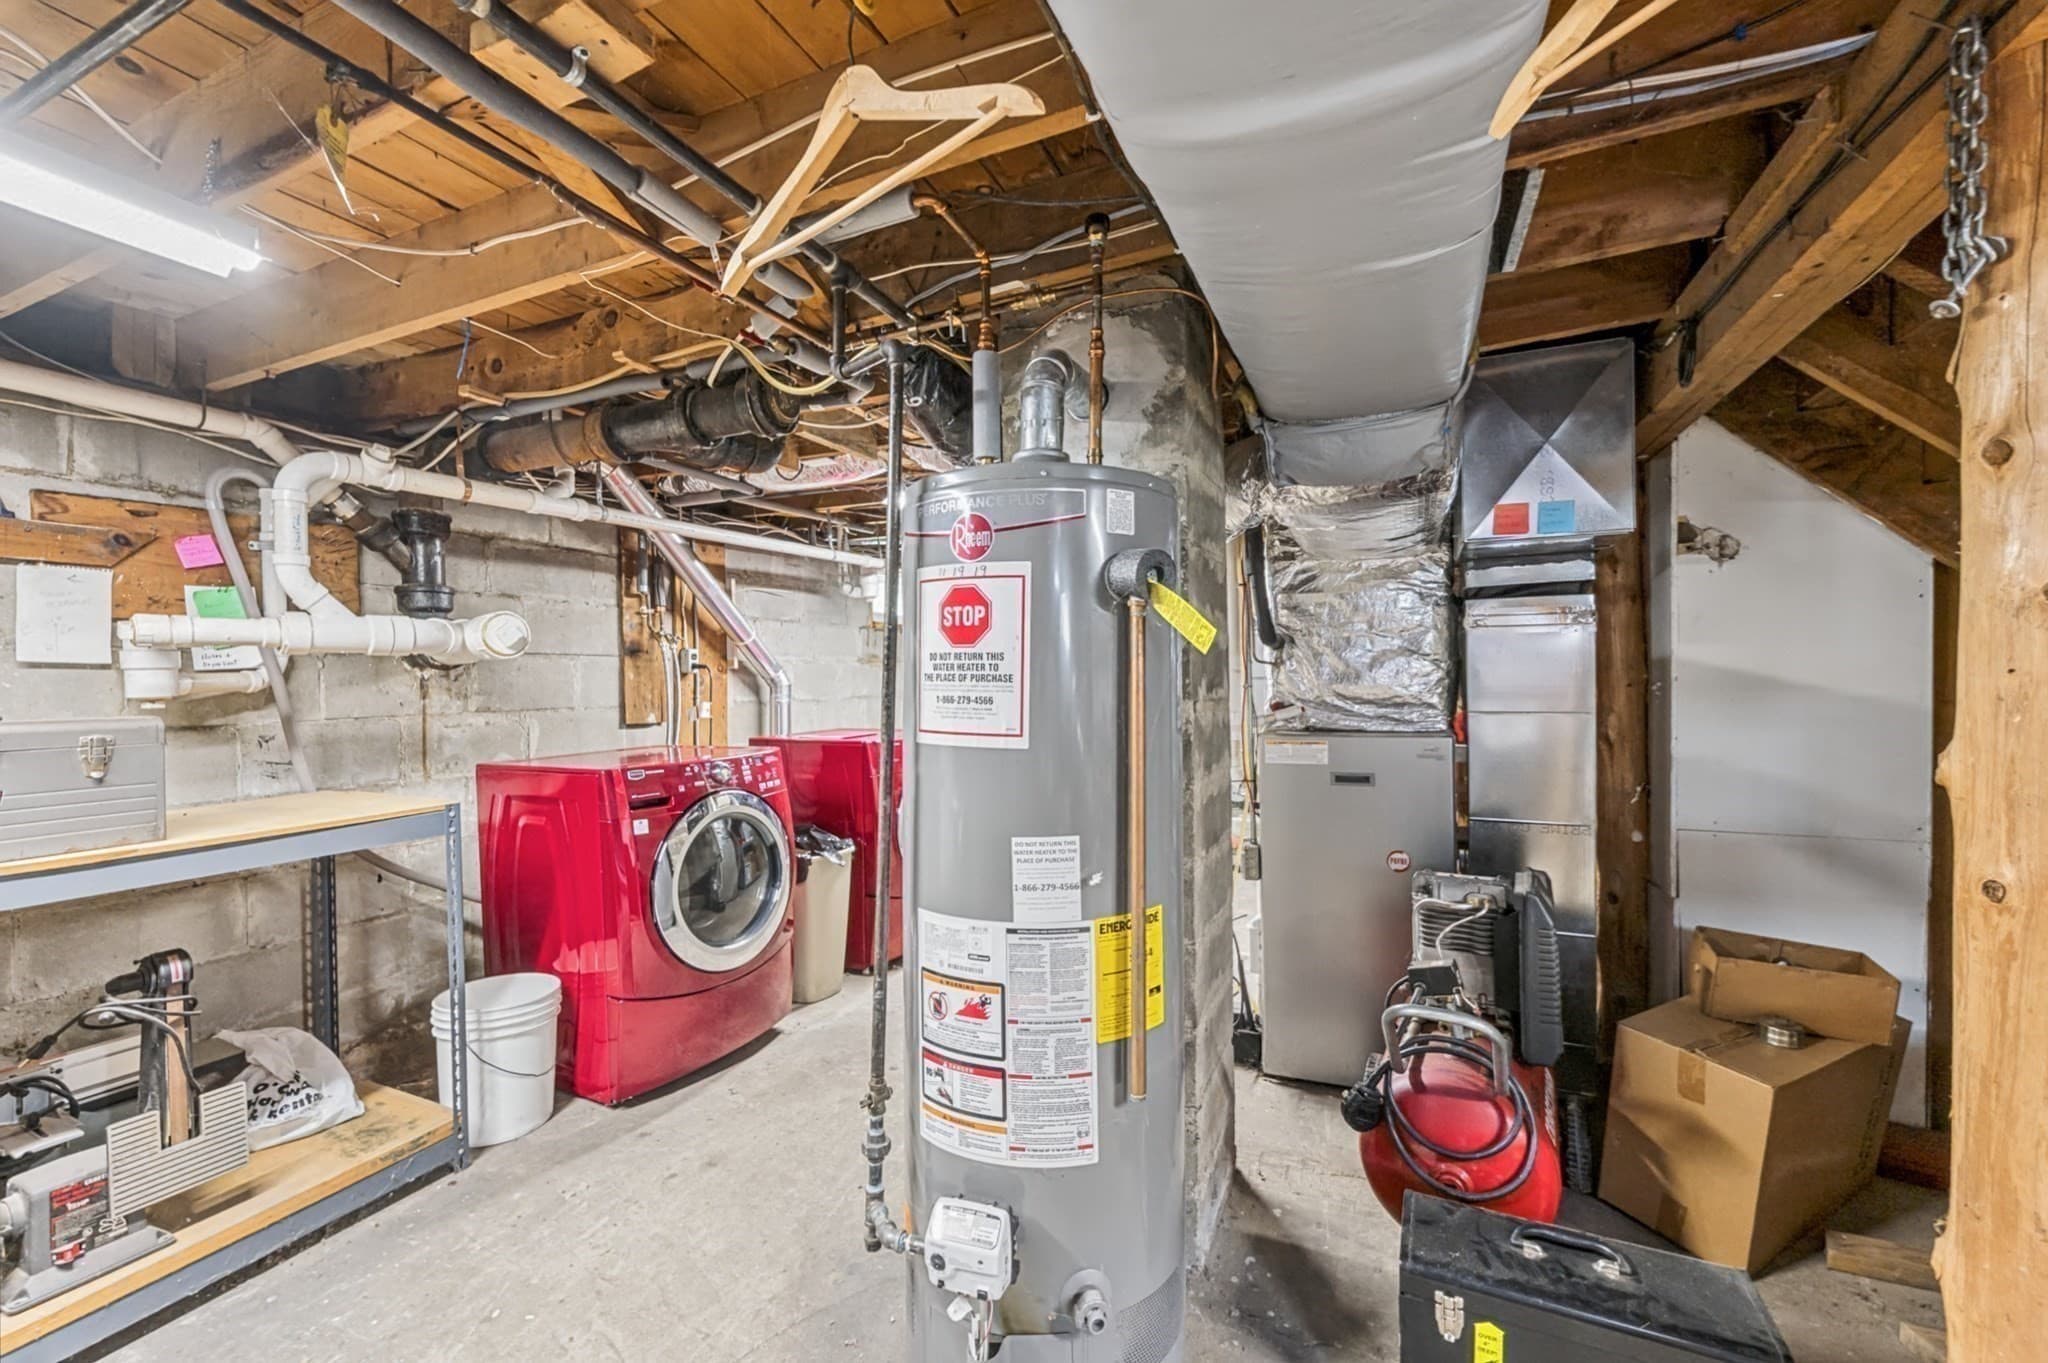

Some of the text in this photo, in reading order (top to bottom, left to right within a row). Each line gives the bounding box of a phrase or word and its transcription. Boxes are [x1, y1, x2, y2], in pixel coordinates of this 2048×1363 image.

[954, 523, 991, 555] Rheem
[943, 605, 986, 627] STOP
[929, 652, 1005, 662] DO NOT RETURN THIS
[933, 663, 999, 672] WATER HEATER TO
[924, 673, 1014, 683] THE PLACE OF PURCHASE
[1014, 882, 1080, 891] 1-866-279-4566
